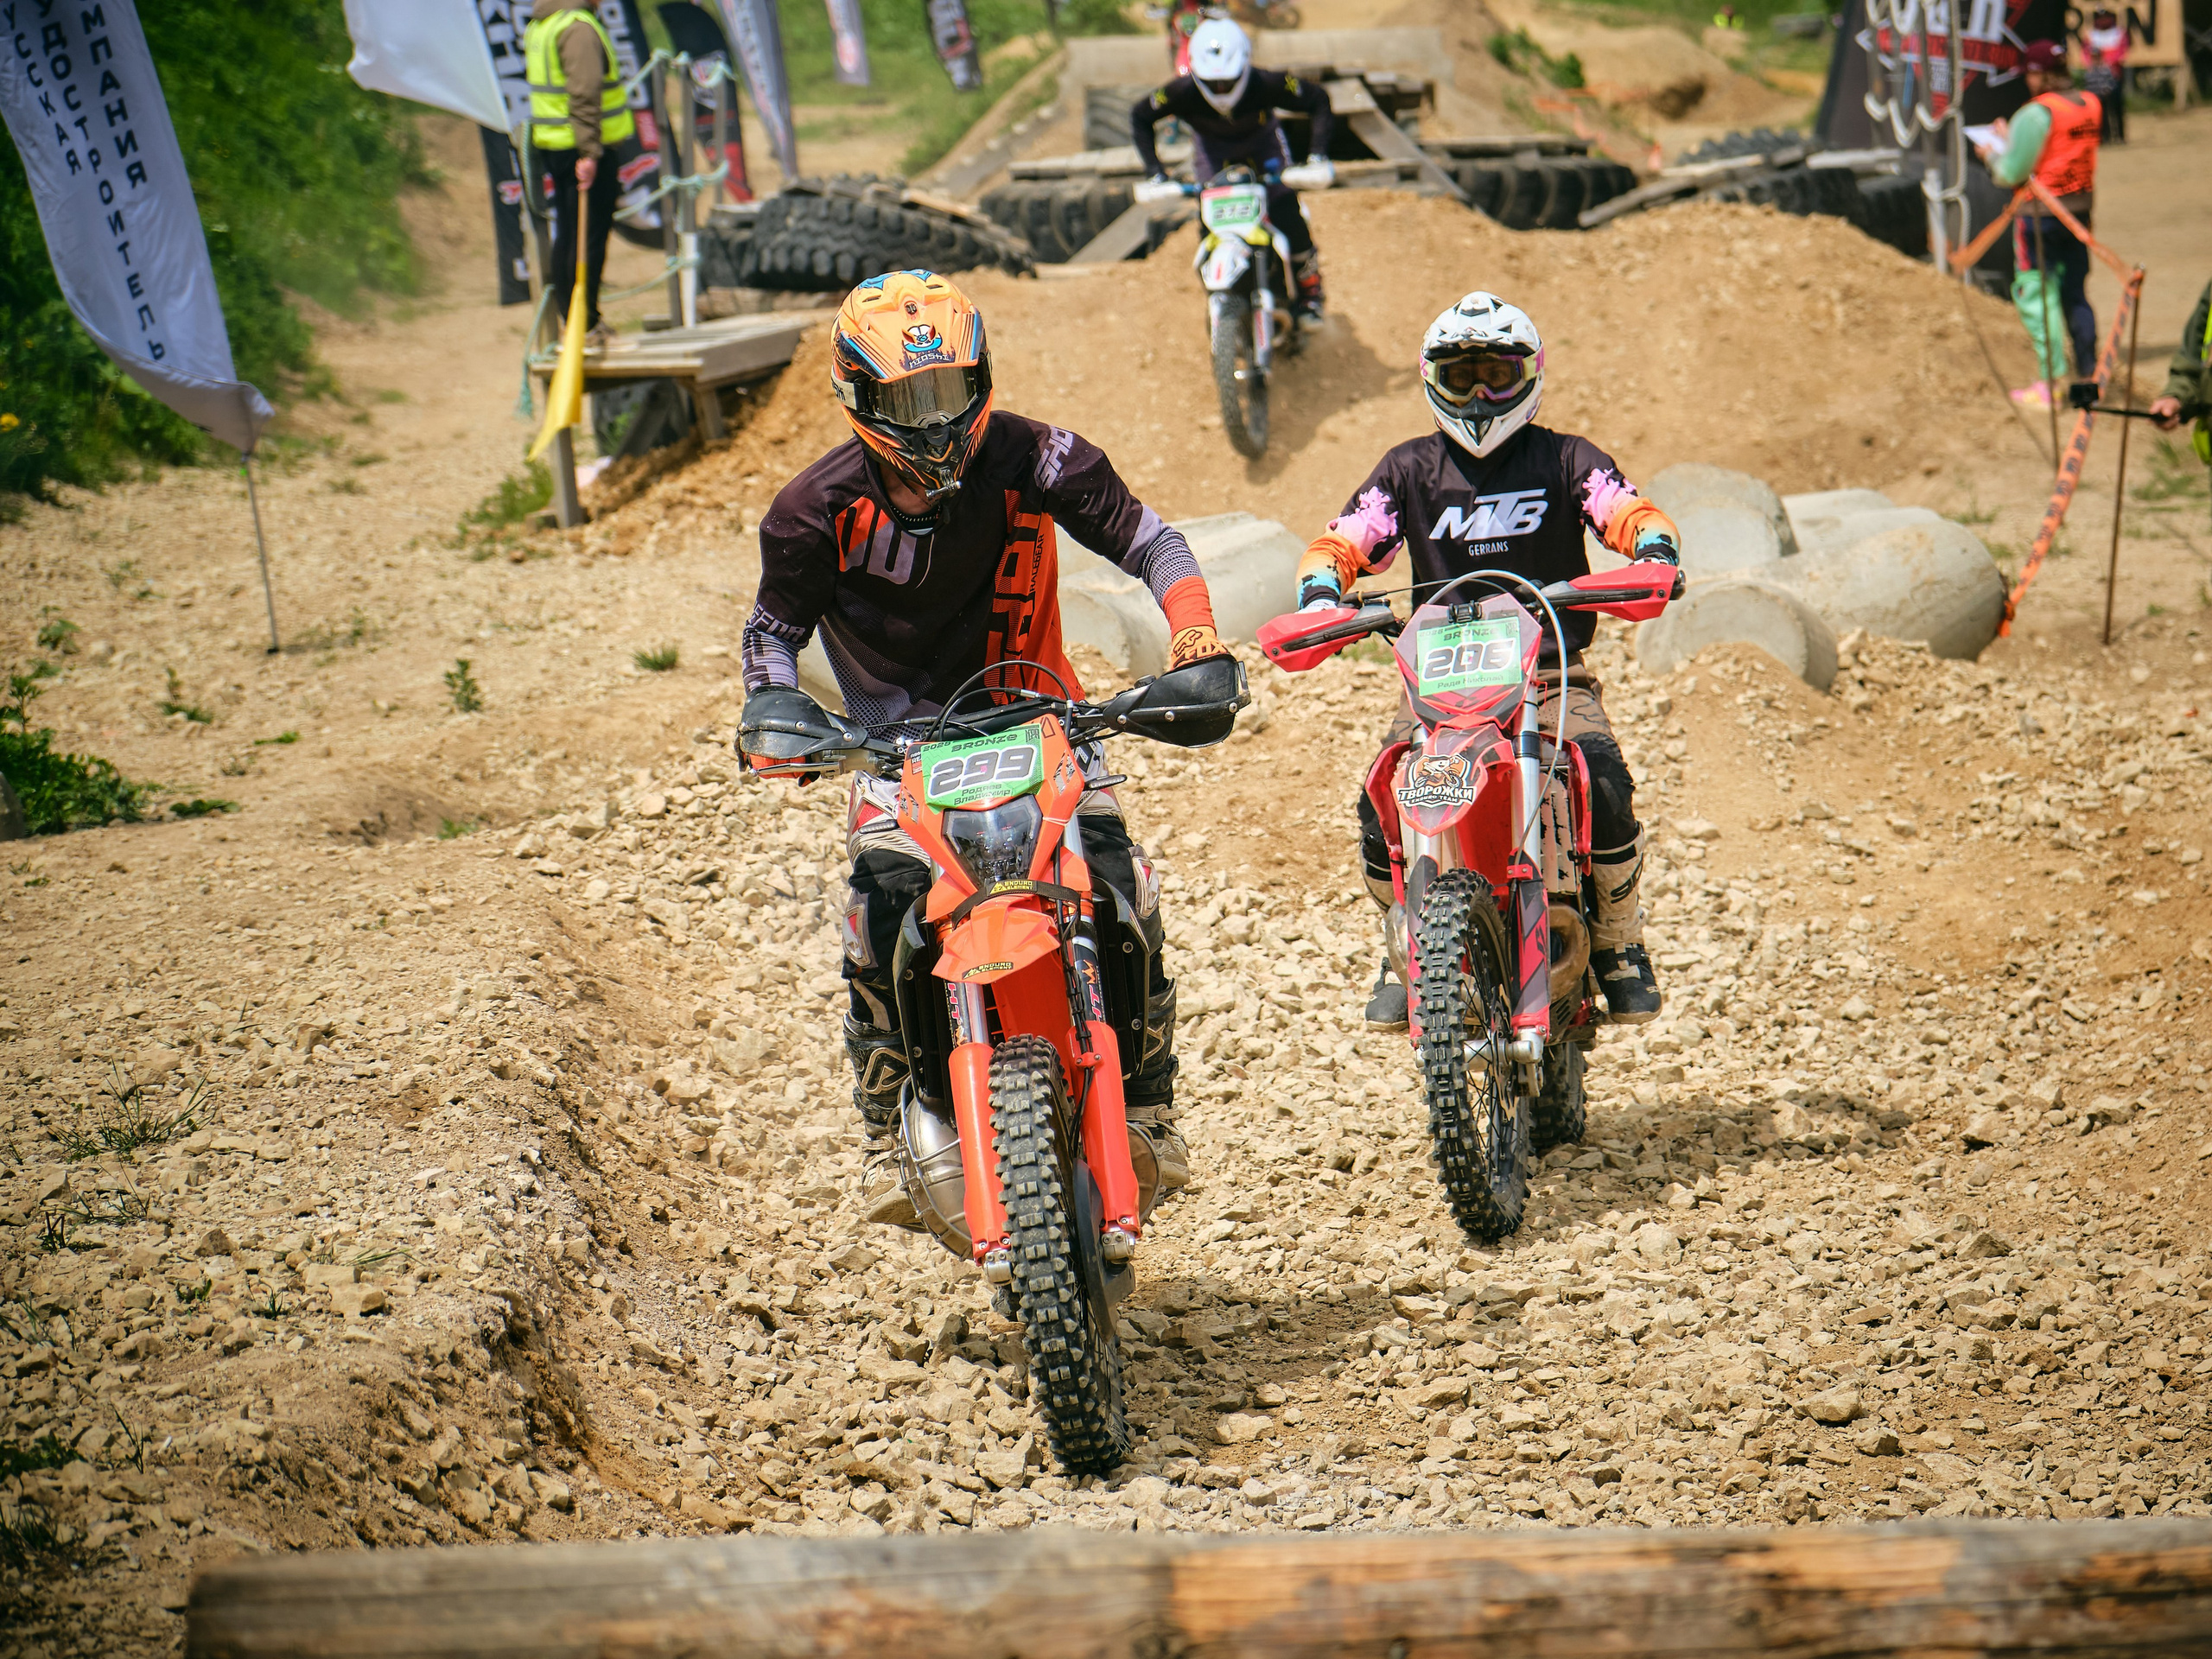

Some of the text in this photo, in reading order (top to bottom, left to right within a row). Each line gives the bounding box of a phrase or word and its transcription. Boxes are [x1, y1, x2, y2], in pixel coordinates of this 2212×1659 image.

[79, 3, 149, 191] МПАНИЯ
[1427, 488, 1549, 542] MTB
[1468, 540, 1510, 557] GERRANS
[1184, 641, 1228, 660] FOX
[928, 745, 1037, 798] 299
[1399, 785, 1473, 802] ТВОРОЖКИ
